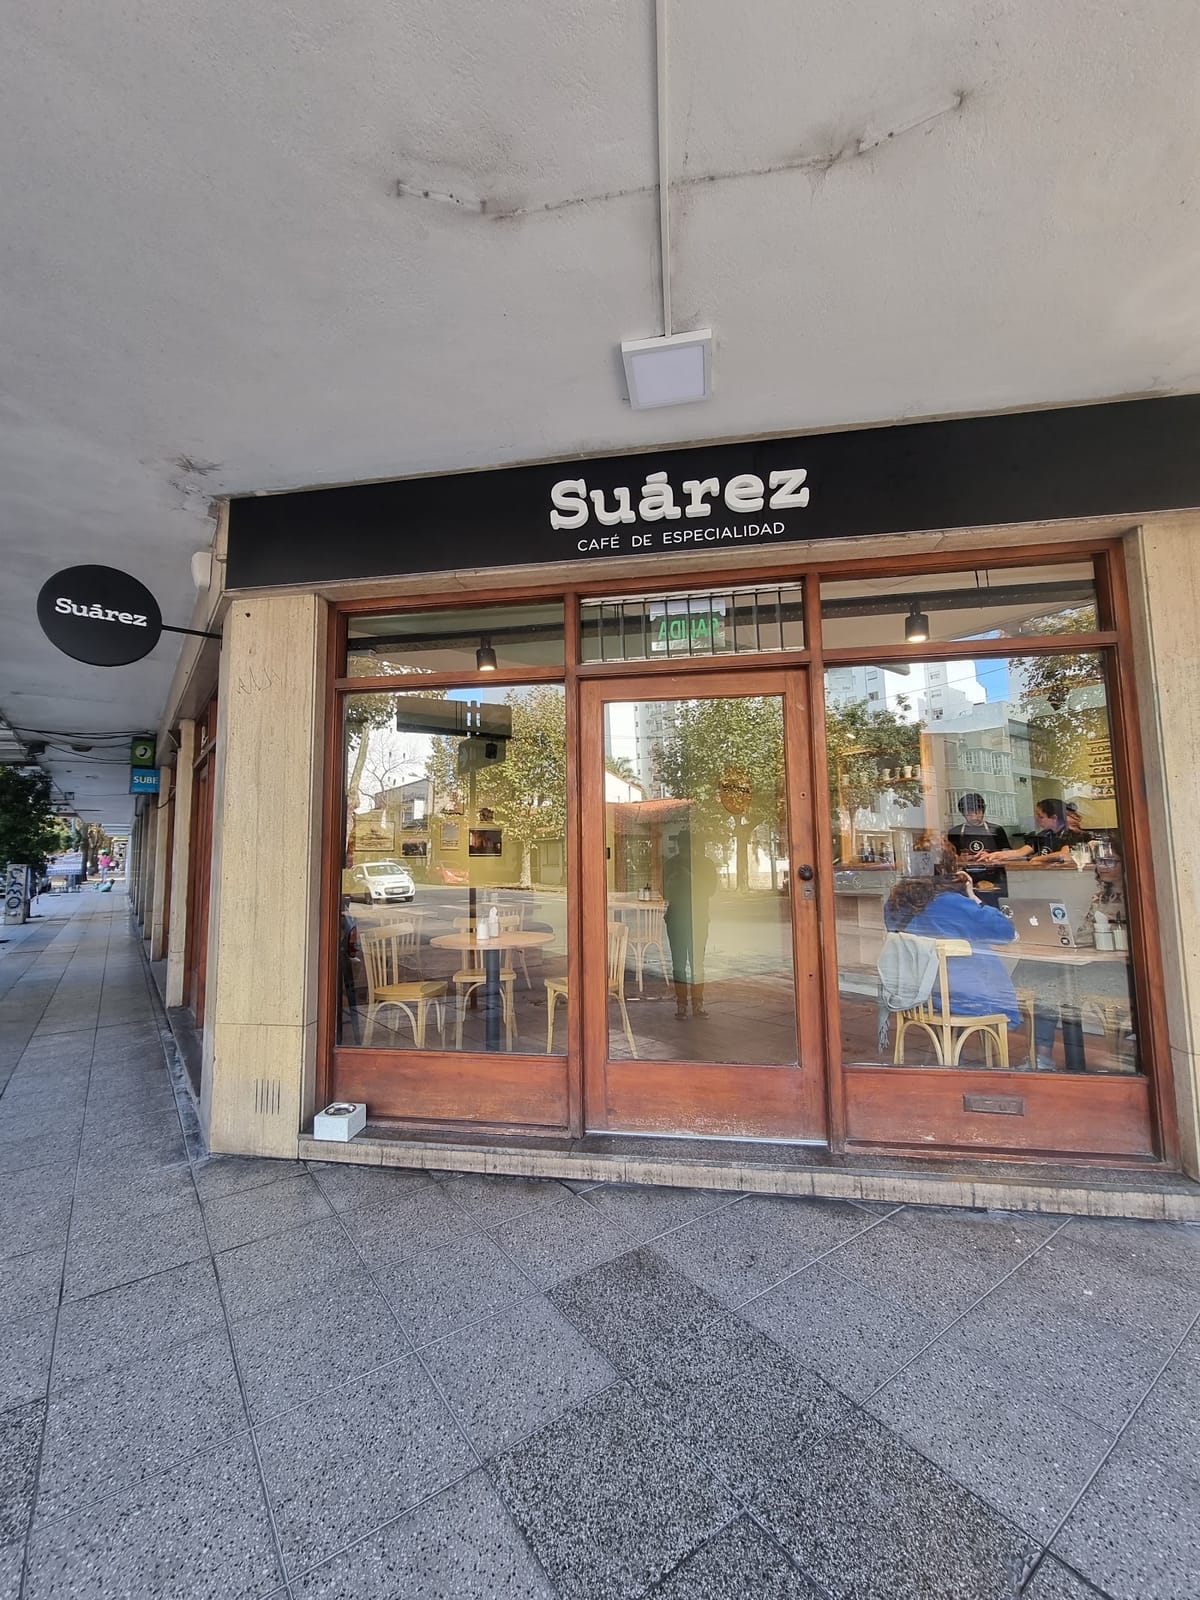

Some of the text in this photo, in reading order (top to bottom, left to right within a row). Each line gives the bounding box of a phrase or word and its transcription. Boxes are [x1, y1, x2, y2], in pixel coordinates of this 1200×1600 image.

[550, 468, 810, 530] Suárez
[577, 522, 785, 551] CAFÉ DE ESPECIALIDAD
[55, 597, 147, 627] Suárez
[133, 776, 159, 784] SUBE
